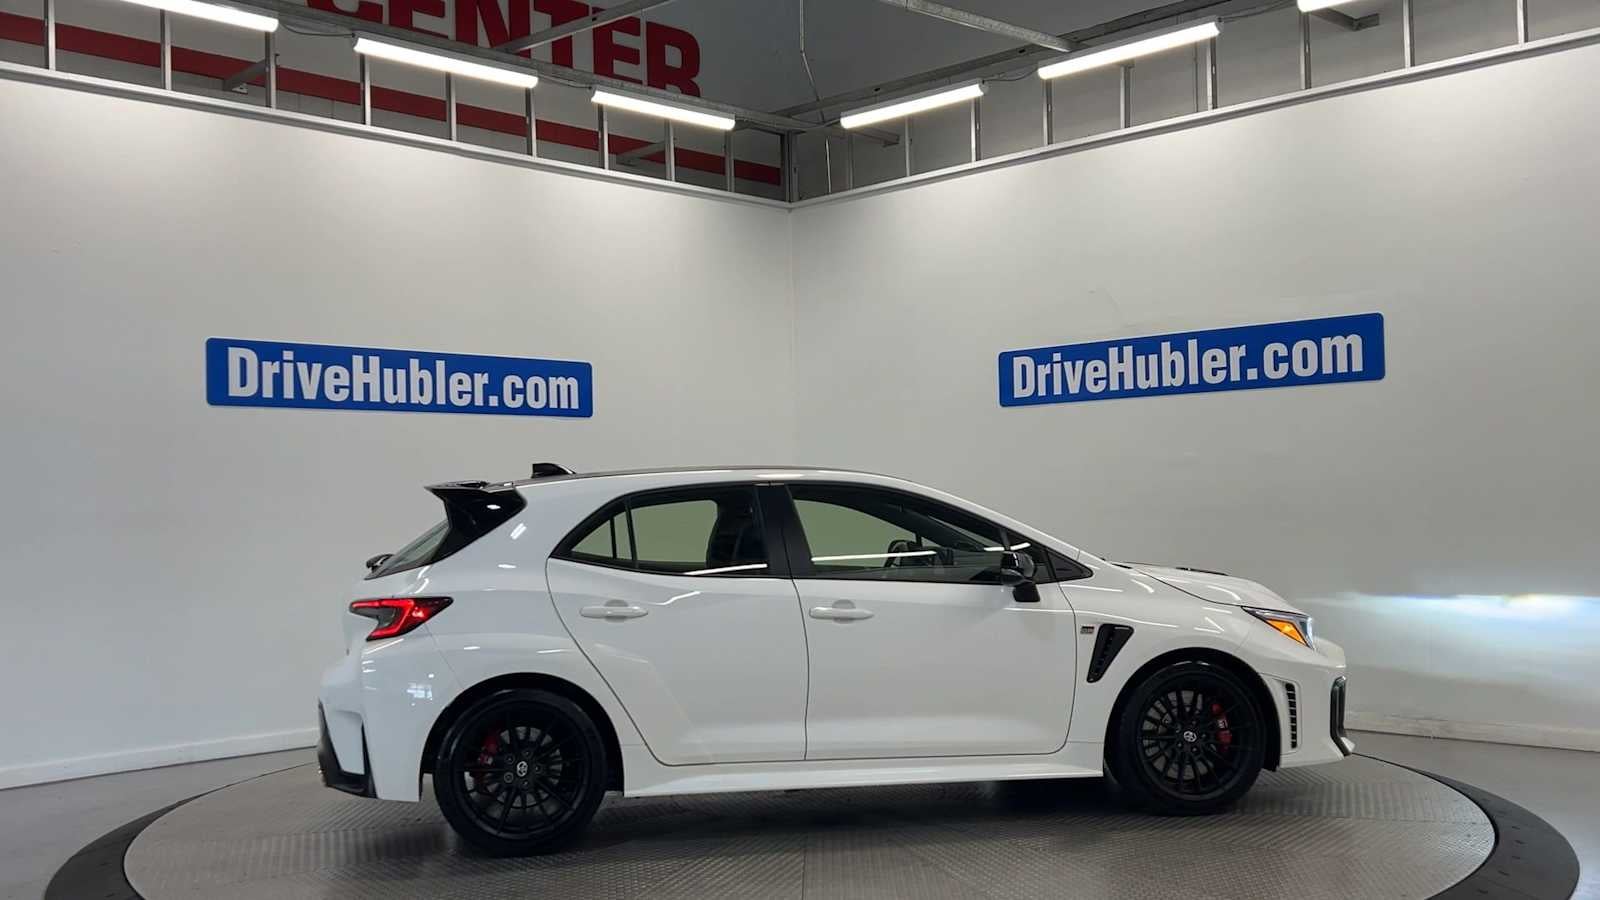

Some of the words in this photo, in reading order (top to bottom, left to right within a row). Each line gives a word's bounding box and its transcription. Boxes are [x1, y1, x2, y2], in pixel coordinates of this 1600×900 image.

[307, 0, 701, 98] ENTER
[227, 347, 580, 410] DriveHubler.com
[1012, 333, 1364, 399] DriveHubler.com
